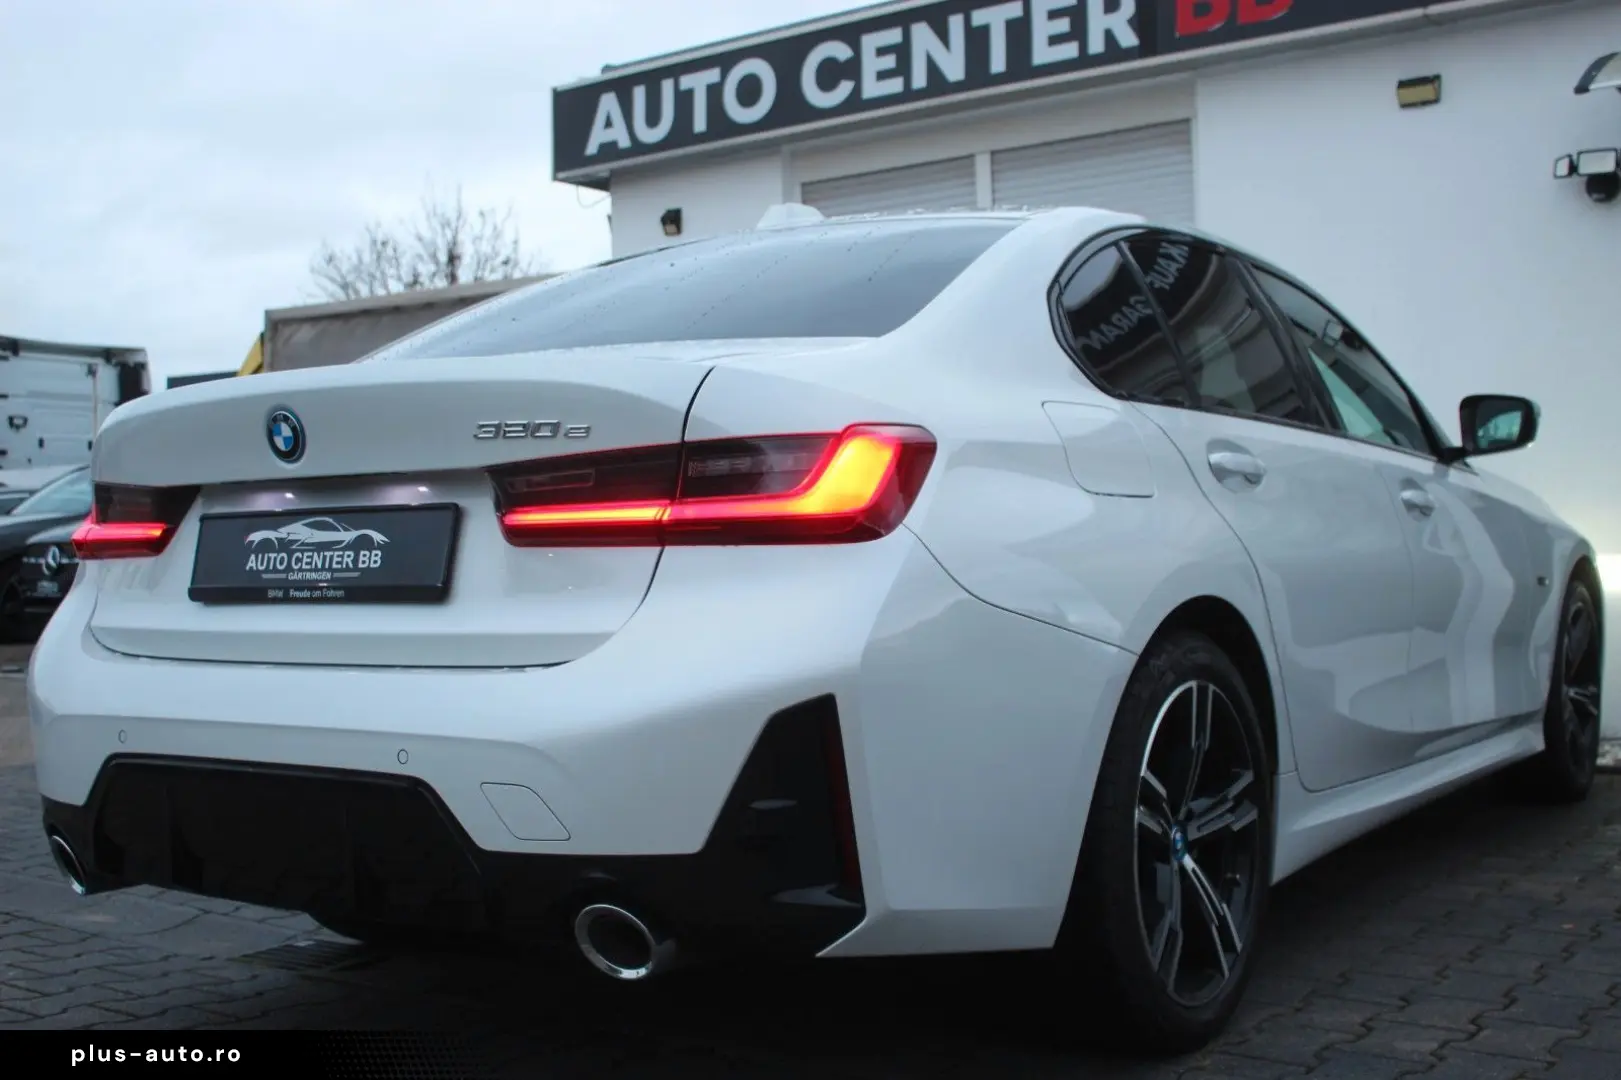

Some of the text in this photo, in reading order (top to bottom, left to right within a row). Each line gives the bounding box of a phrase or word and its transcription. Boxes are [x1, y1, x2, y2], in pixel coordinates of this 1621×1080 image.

[584, 57, 777, 156] AUTO
[800, 0, 1140, 109] CENTER
[246, 550, 382, 571] AUTO CENTER BB
